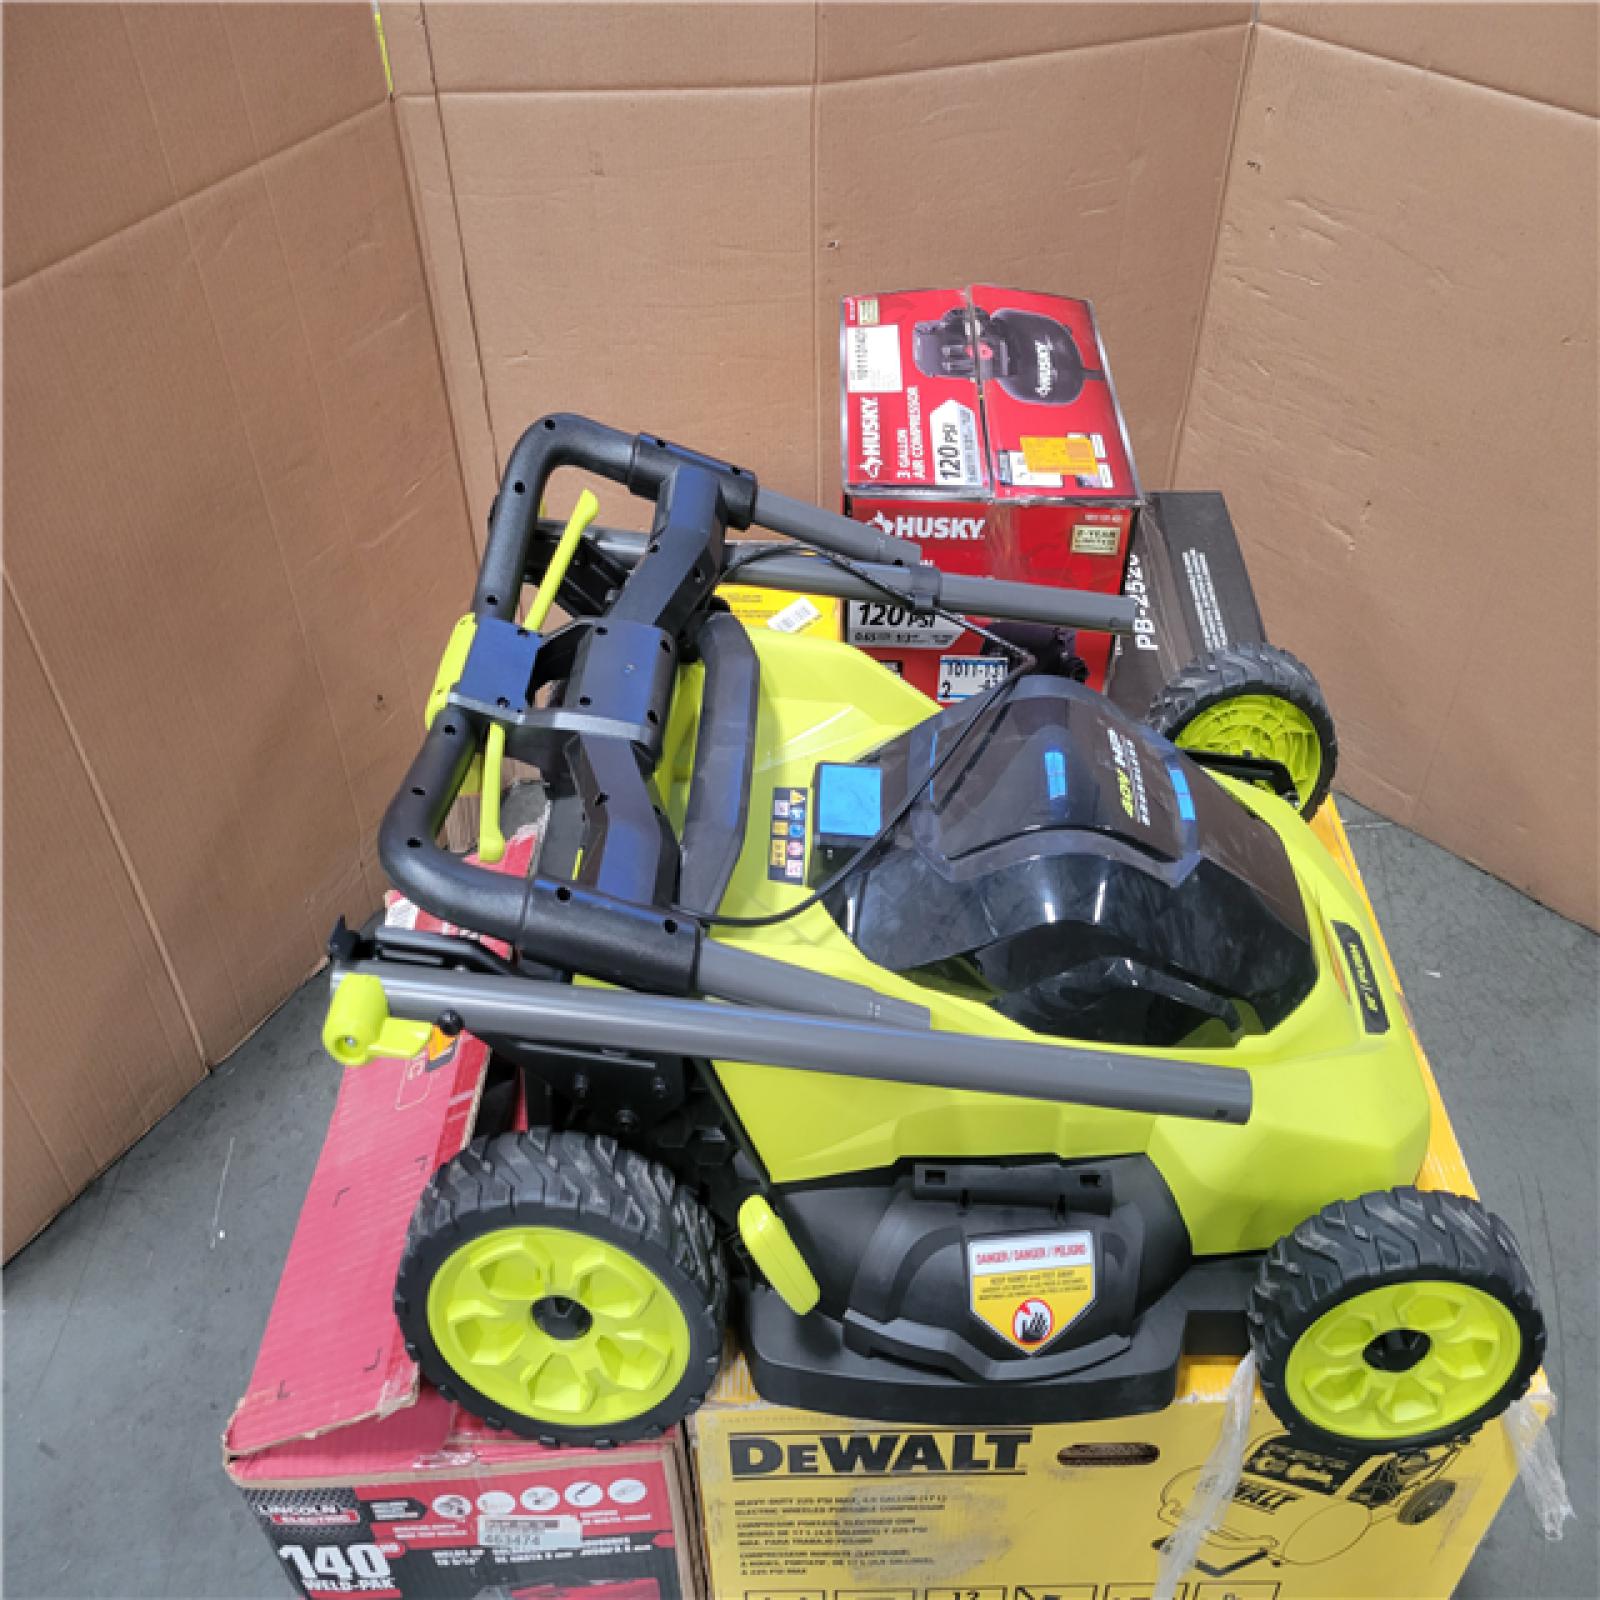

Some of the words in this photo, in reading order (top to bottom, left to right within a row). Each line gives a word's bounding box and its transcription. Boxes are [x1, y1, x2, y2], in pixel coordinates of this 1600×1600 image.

[860, 396, 881, 456] HUSKY
[907, 386, 924, 458] COMPRESSOR
[944, 421, 960, 445] PSI
[896, 428, 909, 470] GALLON
[937, 446, 960, 480] 120
[911, 459, 926, 481] AIR
[895, 516, 985, 540] HUSKY
[858, 602, 904, 626] 120
[259, 1503, 341, 1514] LINCOLN
[278, 1543, 392, 1580] 140
